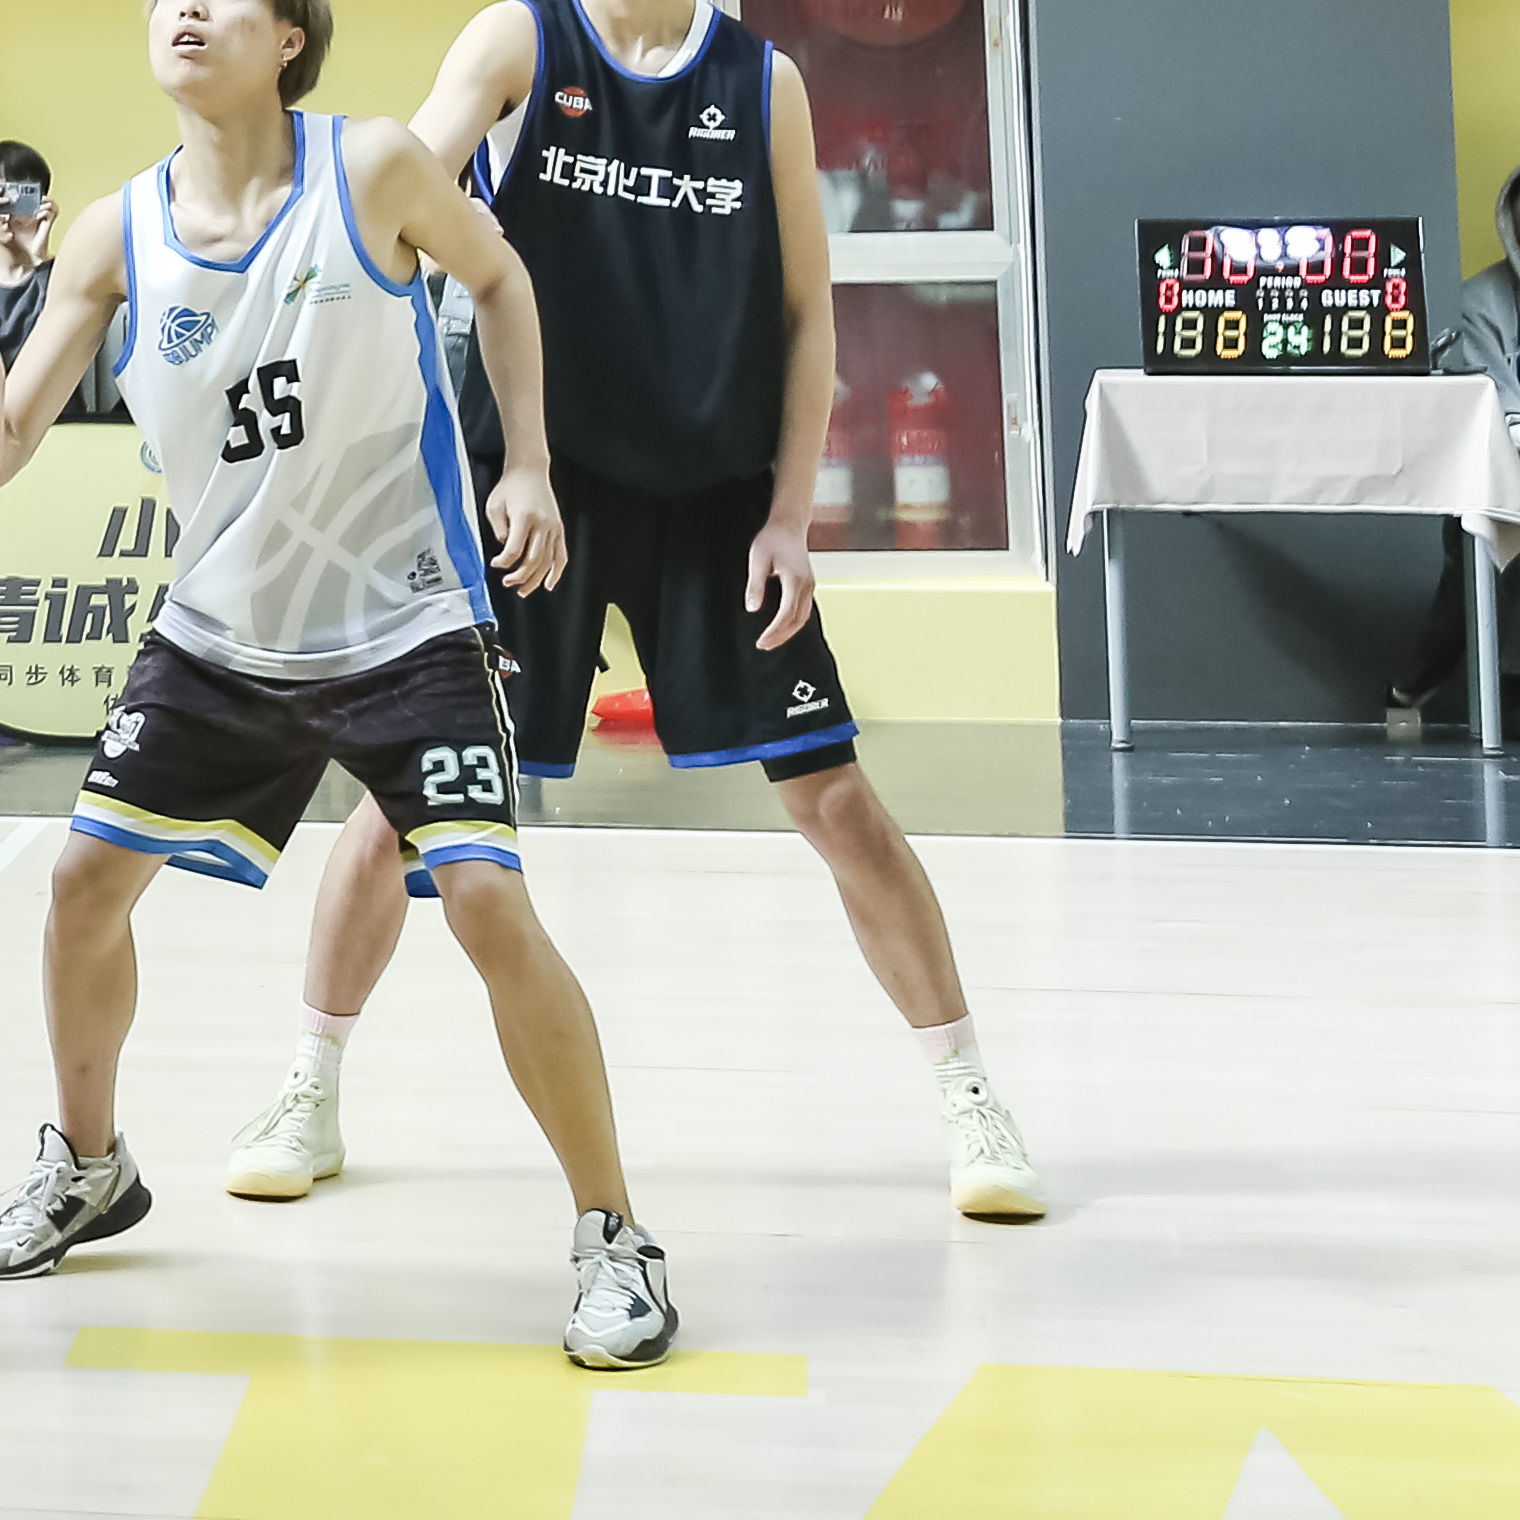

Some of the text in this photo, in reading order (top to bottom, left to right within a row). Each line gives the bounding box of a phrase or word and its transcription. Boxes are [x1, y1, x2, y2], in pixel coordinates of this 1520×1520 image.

[554, 90, 593, 112] CUBA
[539, 145, 744, 215] 北京化工大学
[1260, 276, 1302, 289] PERIOD
[1181, 289, 1236, 308] HOME
[1321, 289, 1382, 308] GUEST
[1261, 321, 1310, 360] 24
[420, 745, 505, 806] 23
